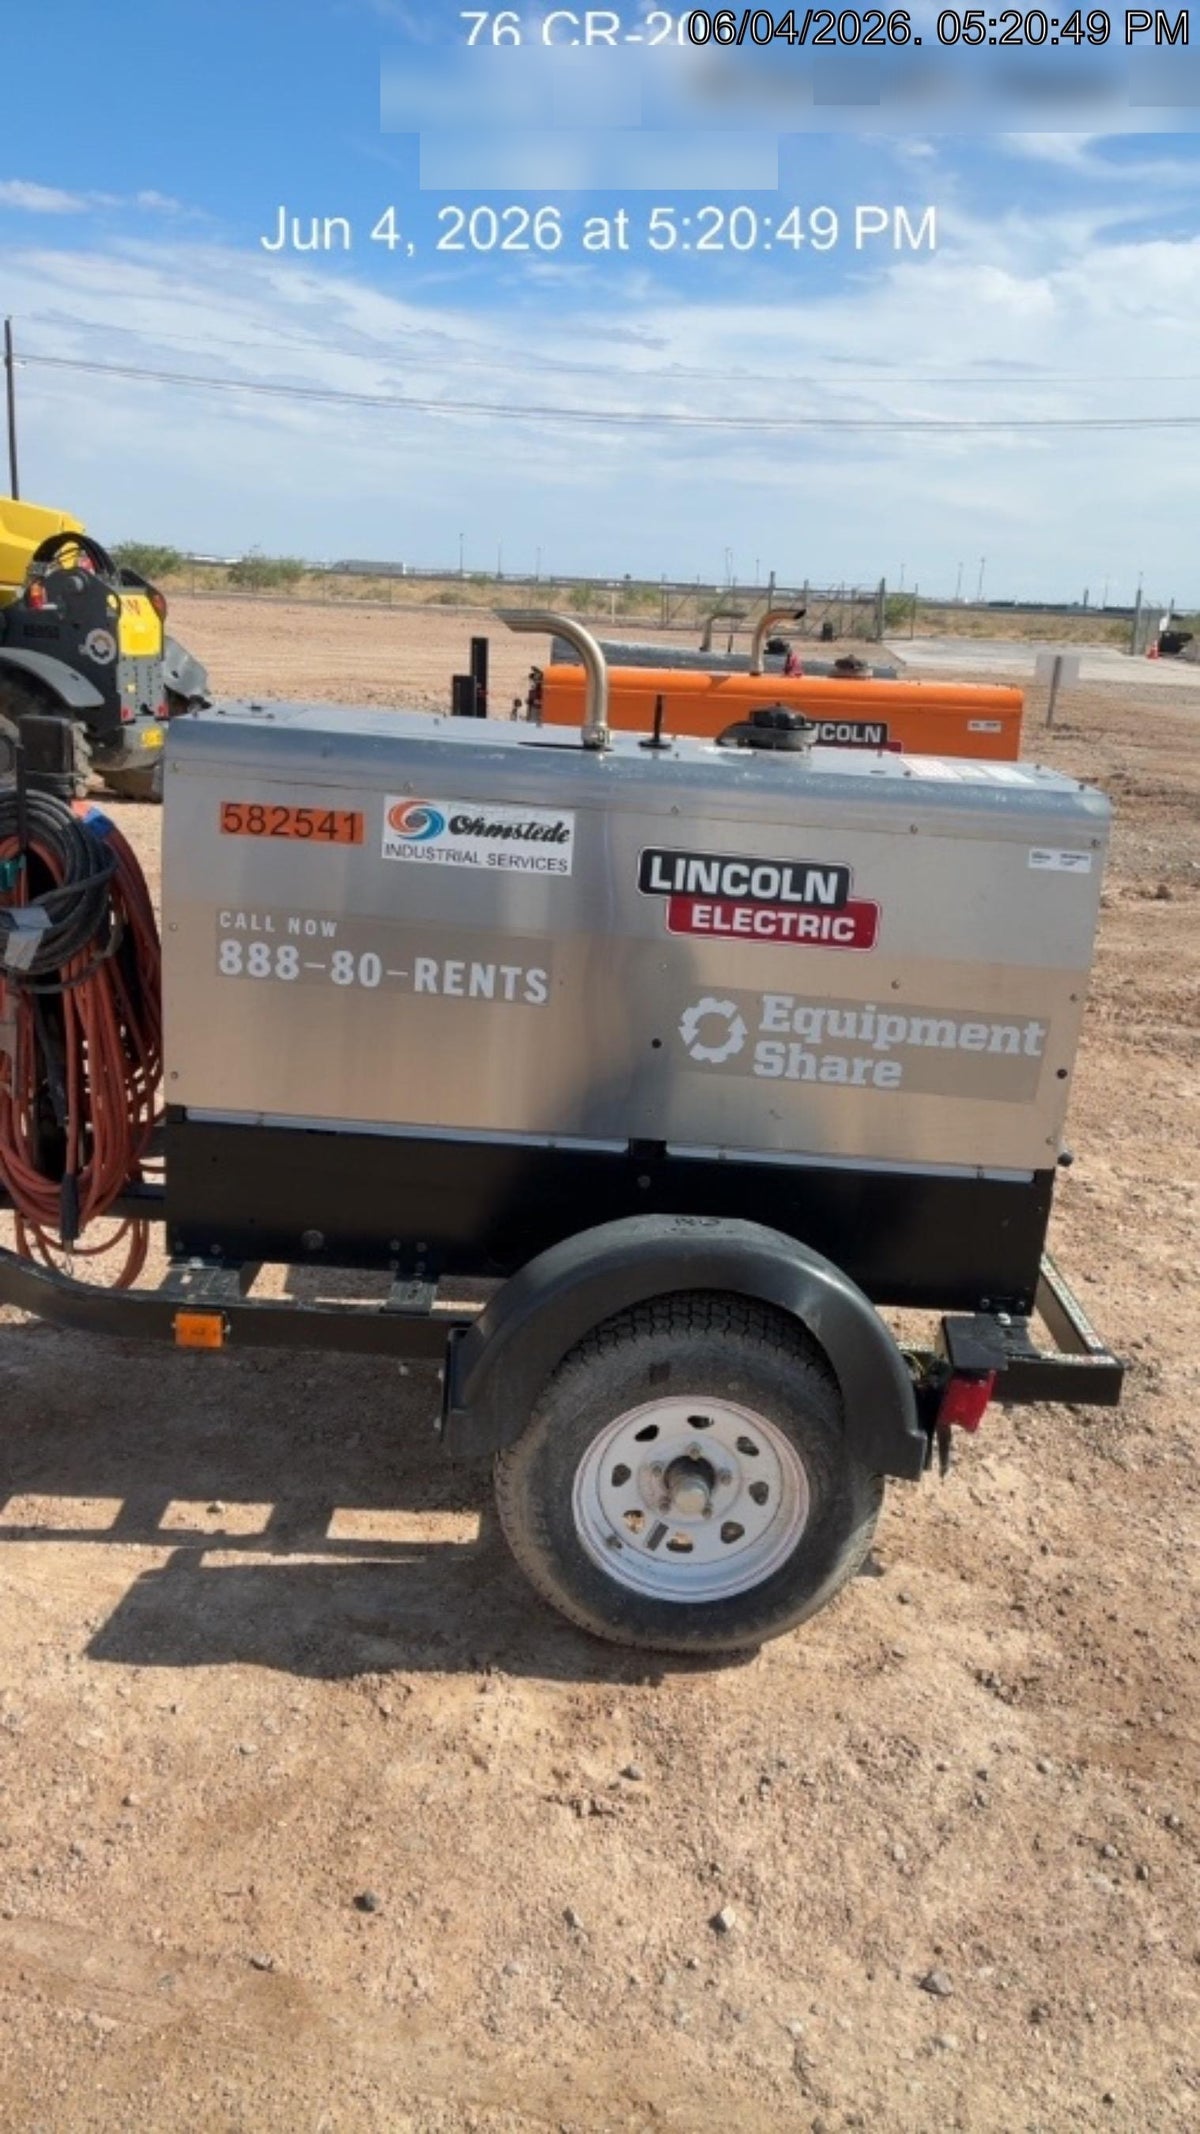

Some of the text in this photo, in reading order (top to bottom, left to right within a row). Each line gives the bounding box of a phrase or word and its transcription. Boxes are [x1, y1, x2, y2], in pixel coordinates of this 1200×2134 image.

[811, 722, 882, 743] COLN
[222, 803, 358, 842] 582541
[448, 814, 571, 844] Ohmstede
[384, 843, 568, 872] INDUSTRIAL SERVICES
[649, 856, 839, 905] LINCOLN
[219, 911, 338, 938] CALL NOW
[691, 905, 856, 942] ELECTRIC
[218, 938, 549, 1004] 888-80-RENTS
[759, 994, 1046, 1057] Equipment
[753, 1041, 903, 1088] Share
